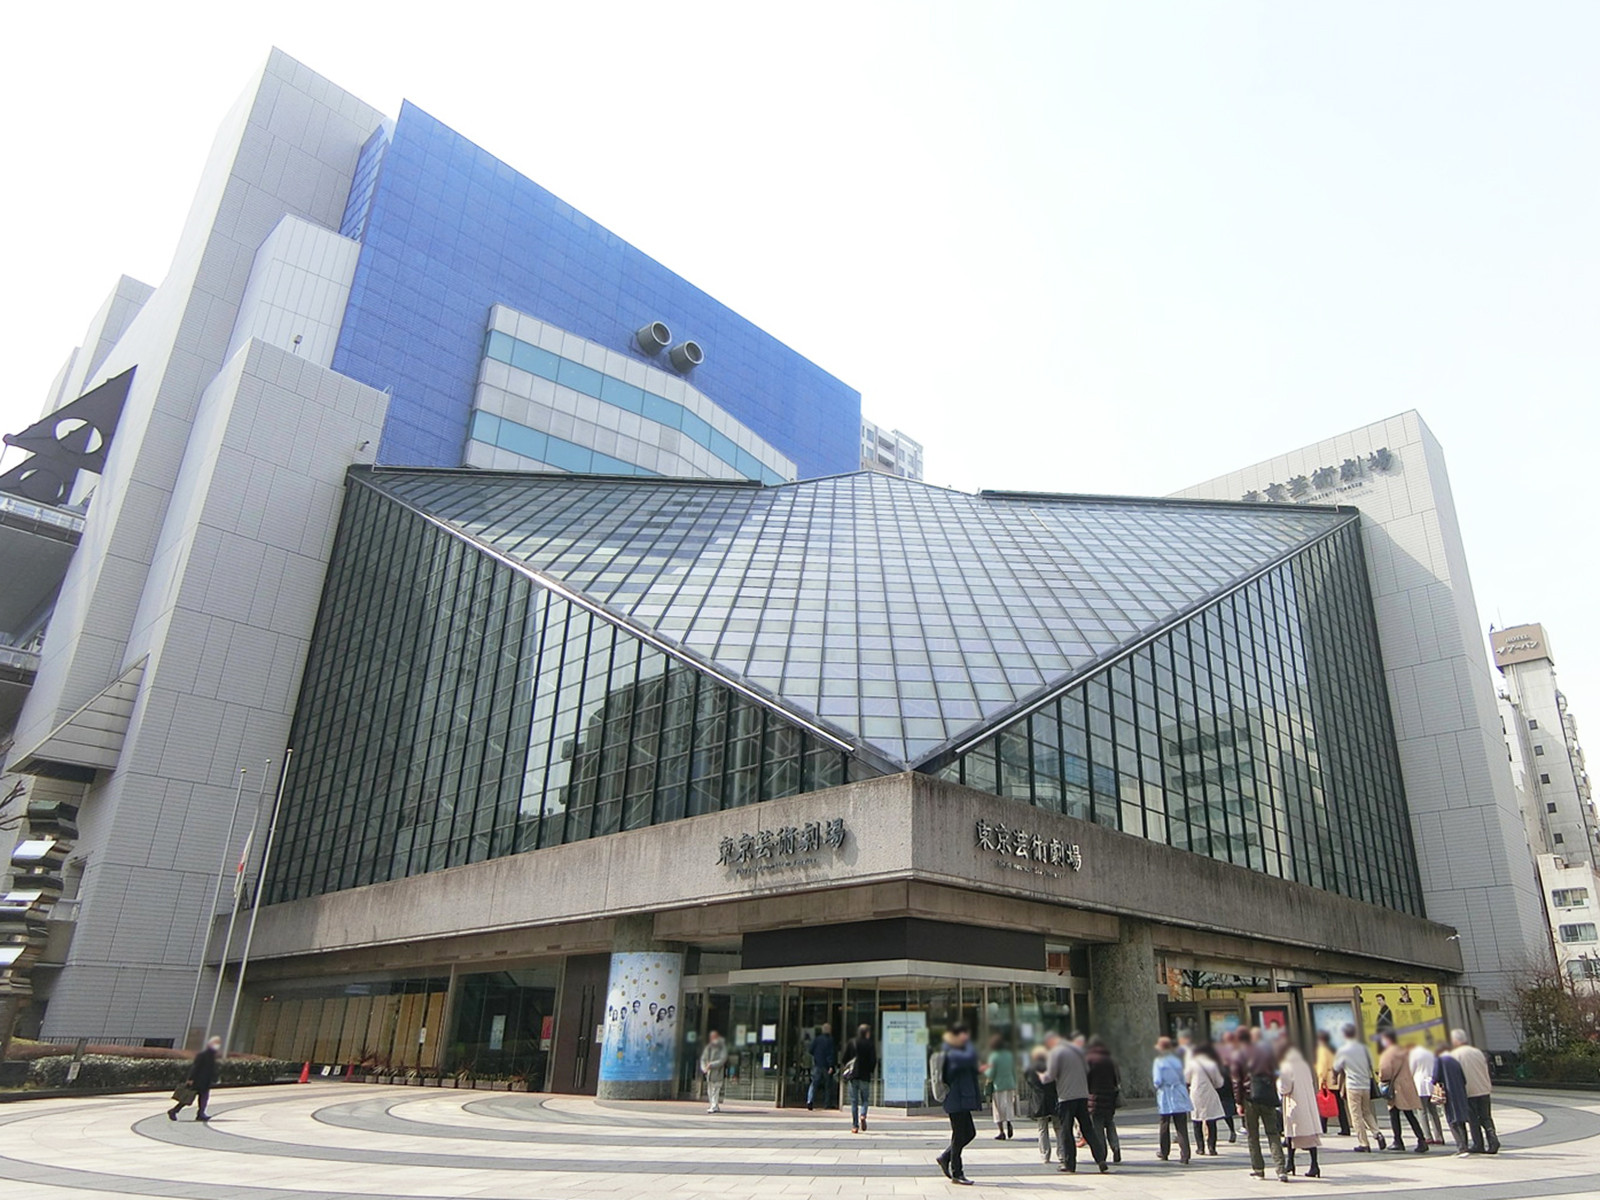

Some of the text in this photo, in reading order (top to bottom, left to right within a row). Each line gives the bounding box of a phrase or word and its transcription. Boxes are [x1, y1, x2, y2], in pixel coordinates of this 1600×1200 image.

[715, 818, 846, 866] 東京芸術劇場
[975, 819, 1082, 873] 東京芸術劇場
